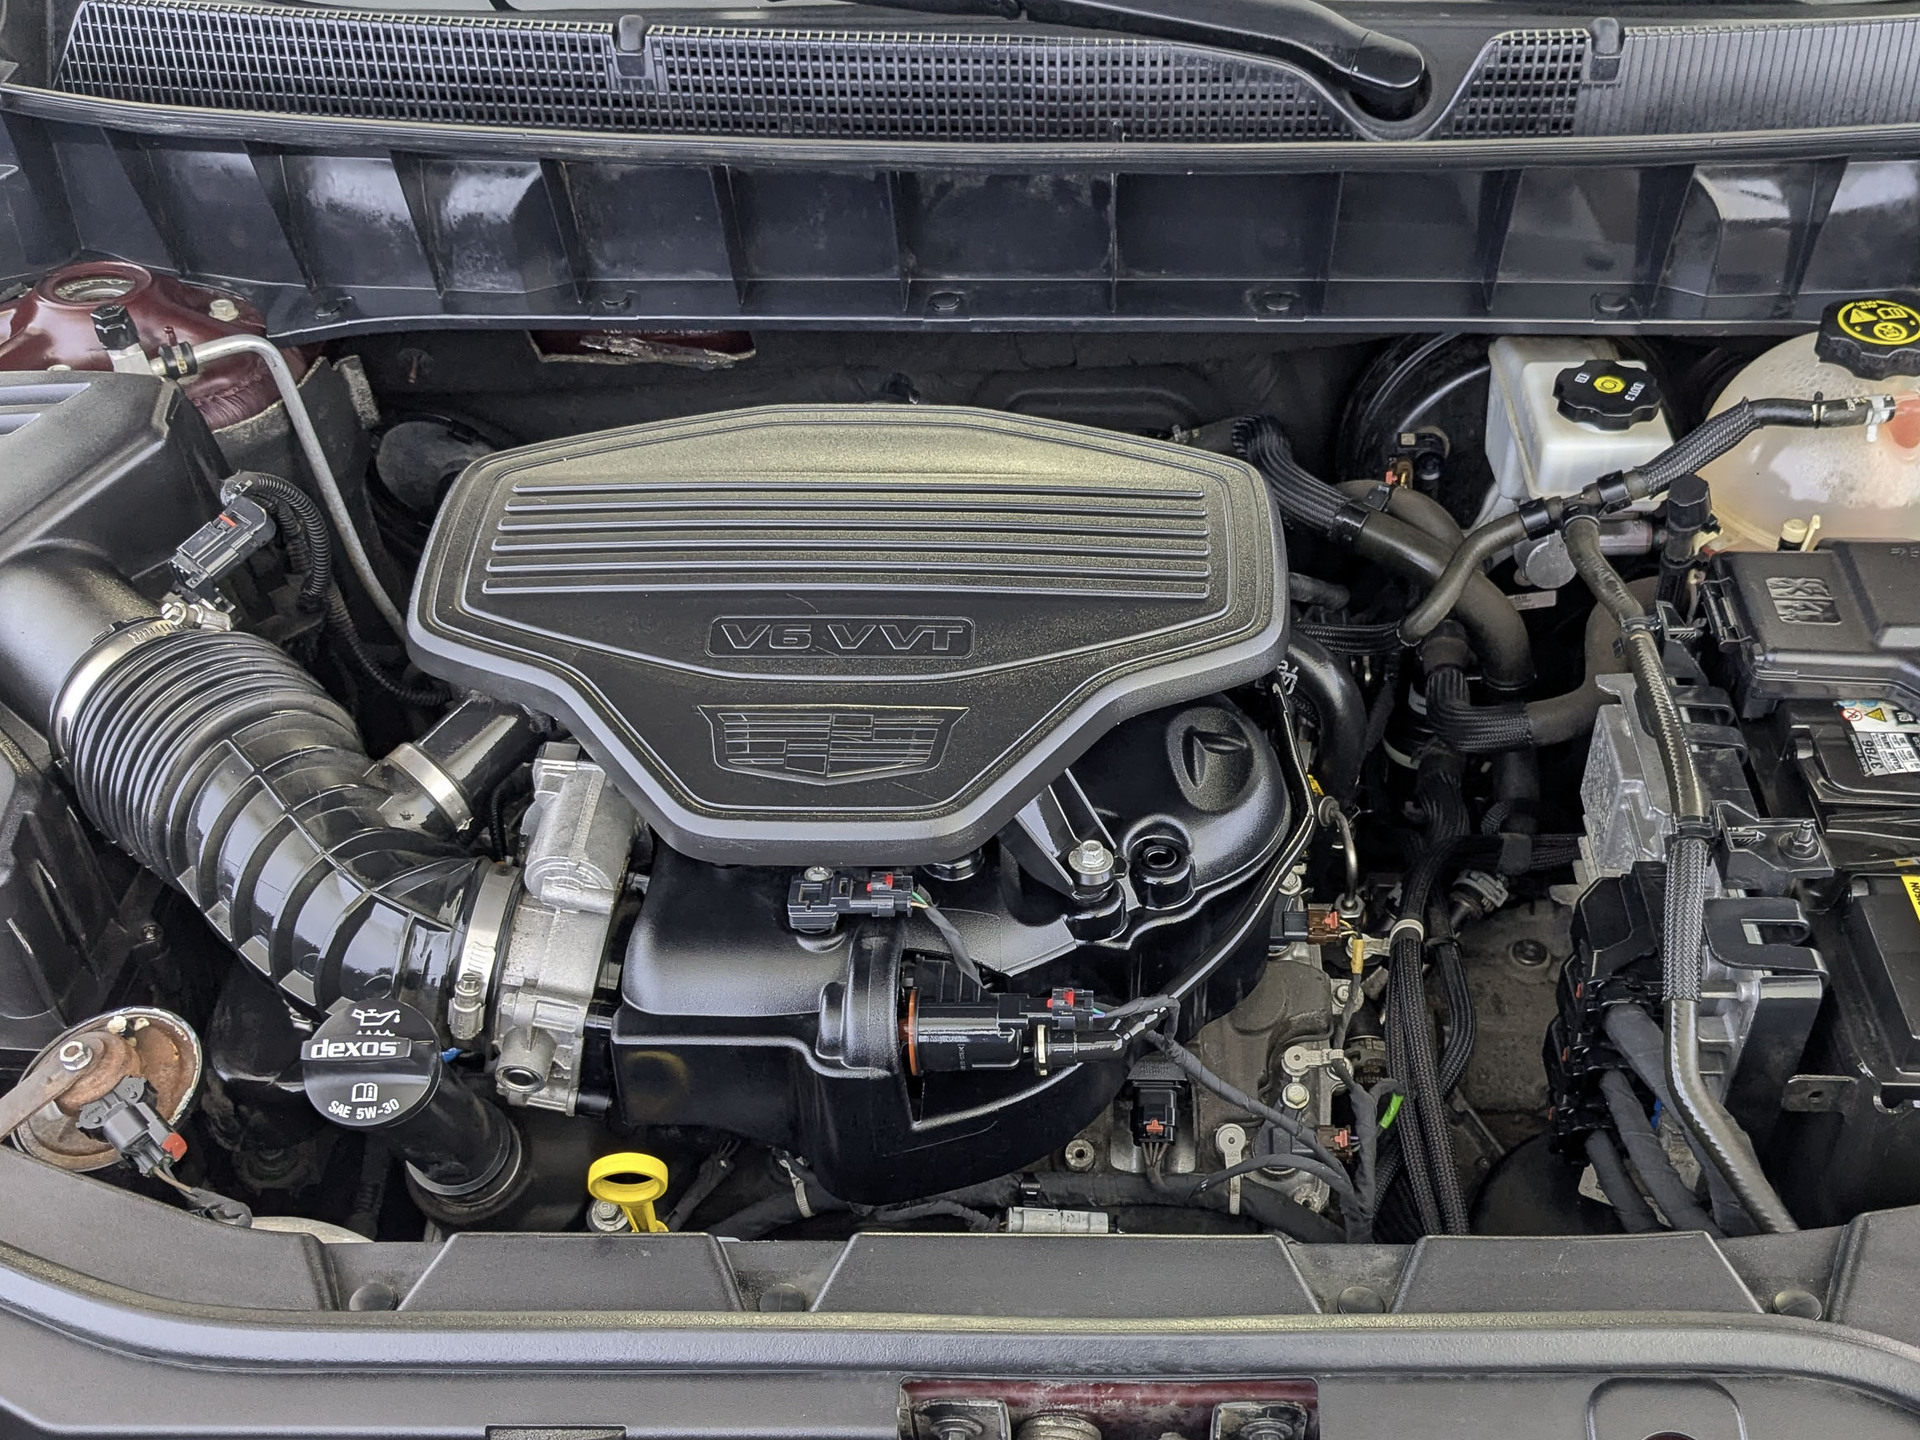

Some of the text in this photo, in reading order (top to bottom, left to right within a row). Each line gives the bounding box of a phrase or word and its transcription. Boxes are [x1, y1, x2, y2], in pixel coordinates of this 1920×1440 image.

[721, 624, 964, 651] V6 VVT
[1861, 740, 1883, 769] 3786
[310, 1038, 397, 1059] dexos
[328, 1098, 400, 1120] SAE 5W-30
